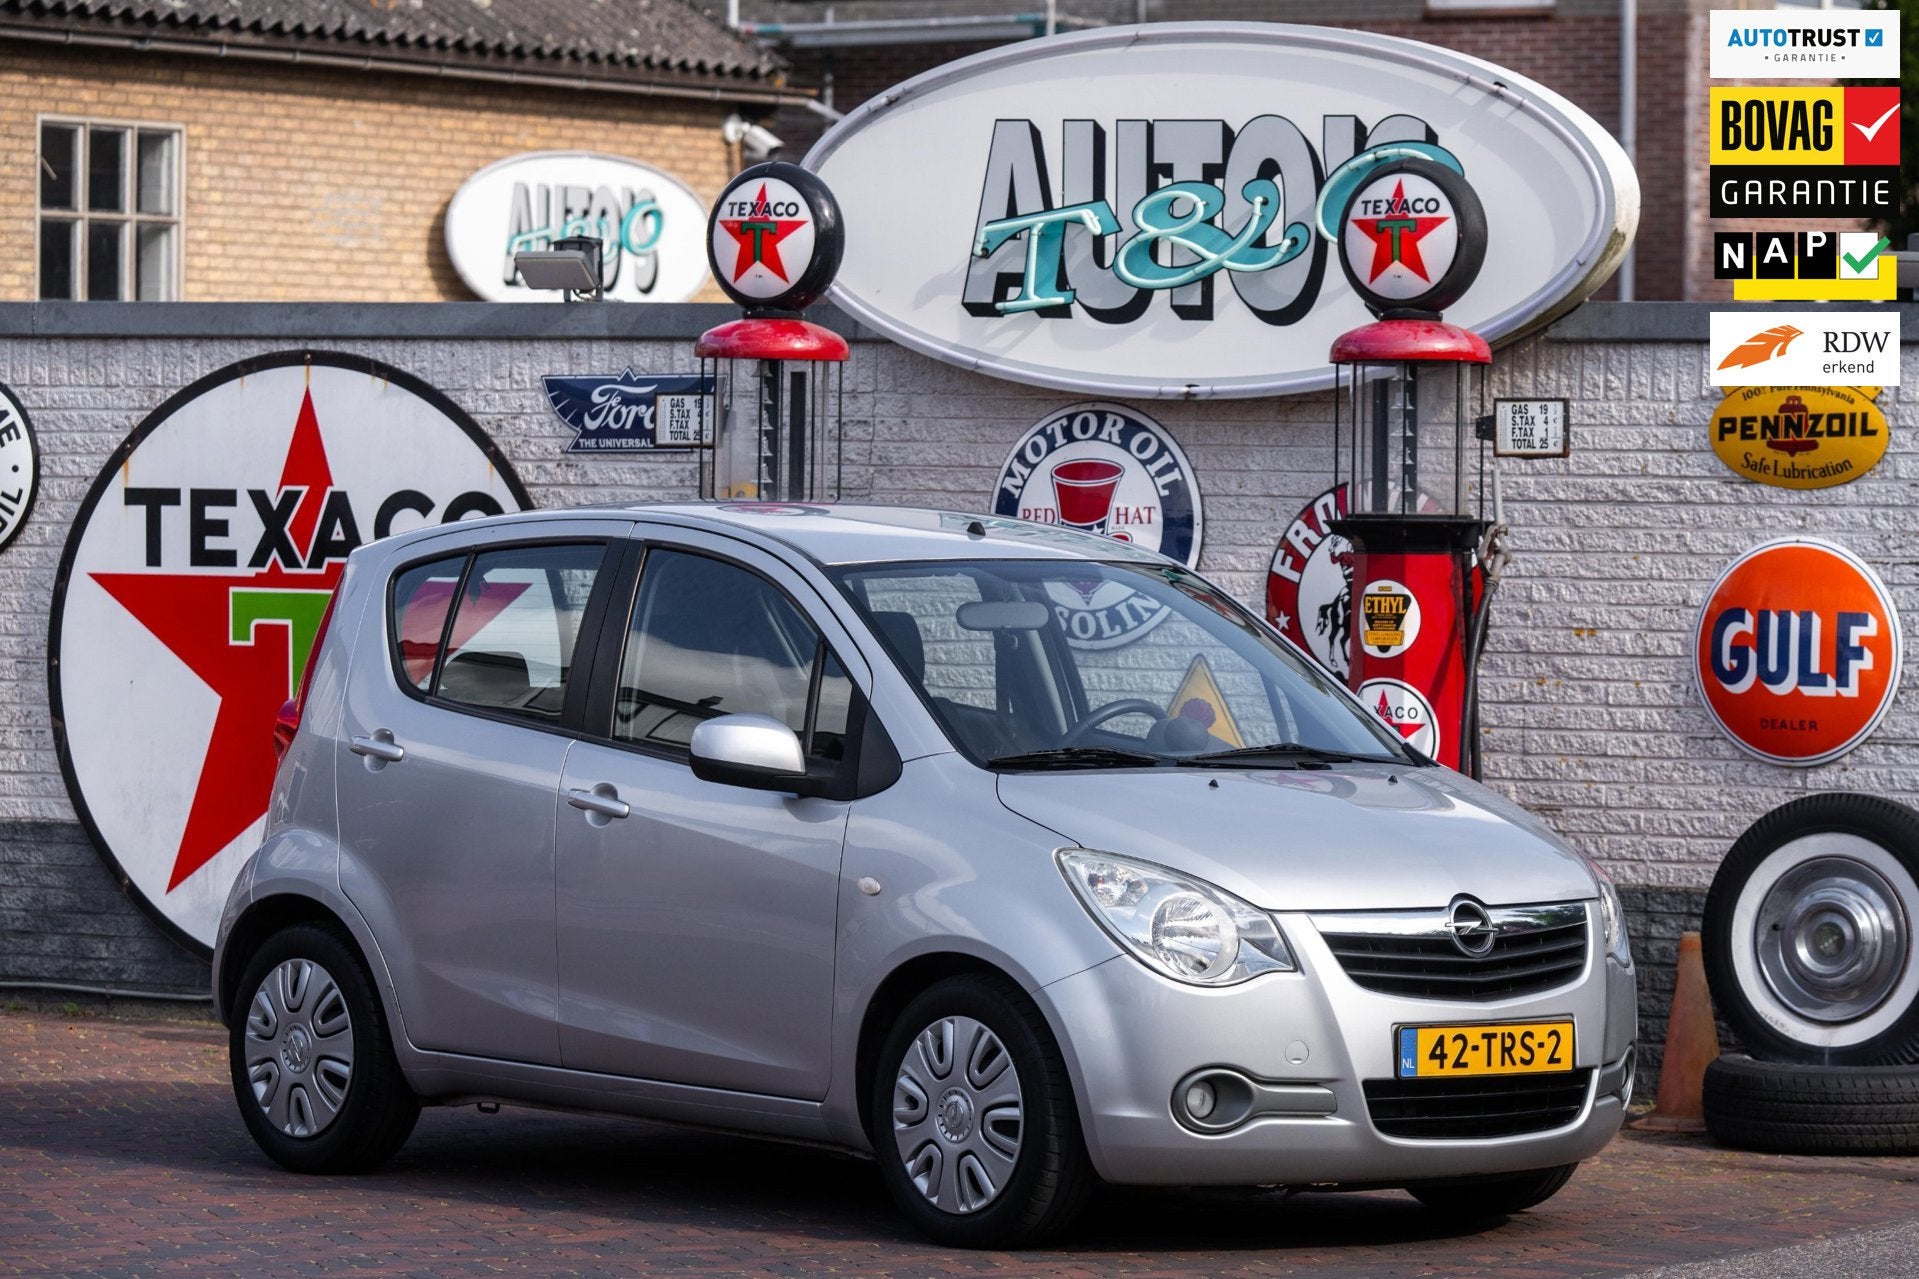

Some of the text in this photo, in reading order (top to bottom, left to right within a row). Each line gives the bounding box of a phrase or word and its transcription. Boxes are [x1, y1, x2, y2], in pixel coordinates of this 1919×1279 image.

[728, 201, 800, 217] TEXACO
[1361, 198, 1440, 215] TEXACO
[670, 398, 685, 408] GAS
[669, 409, 690, 419] S.TAX
[1511, 404, 1528, 415] GAS
[1539, 404, 1548, 415] 19
[669, 420, 689, 430] F.TAX
[1511, 416, 1535, 426] S.TAX
[1543, 416, 1548, 426] 4
[1718, 411, 1879, 441] PENNZOIL
[669, 430, 691, 440] TOTAL
[1511, 427, 1534, 437] F.TAX
[579, 438, 654, 448] THE UNIVERSAL
[1512, 439, 1536, 449] TOTAL
[1540, 439, 1549, 449] 25
[1002, 412, 1183, 500] MOTOR OIL
[1741, 452, 1853, 480] Safe Lubrication
[1115, 506, 1156, 525] HAT
[1364, 596, 1407, 614] ETHYL
[1711, 607, 1878, 698] GULF
[1760, 718, 1818, 731] DEALER
[1429, 1029, 1562, 1070] 42-TRS-2
[1402, 1058, 1415, 1069] NL
